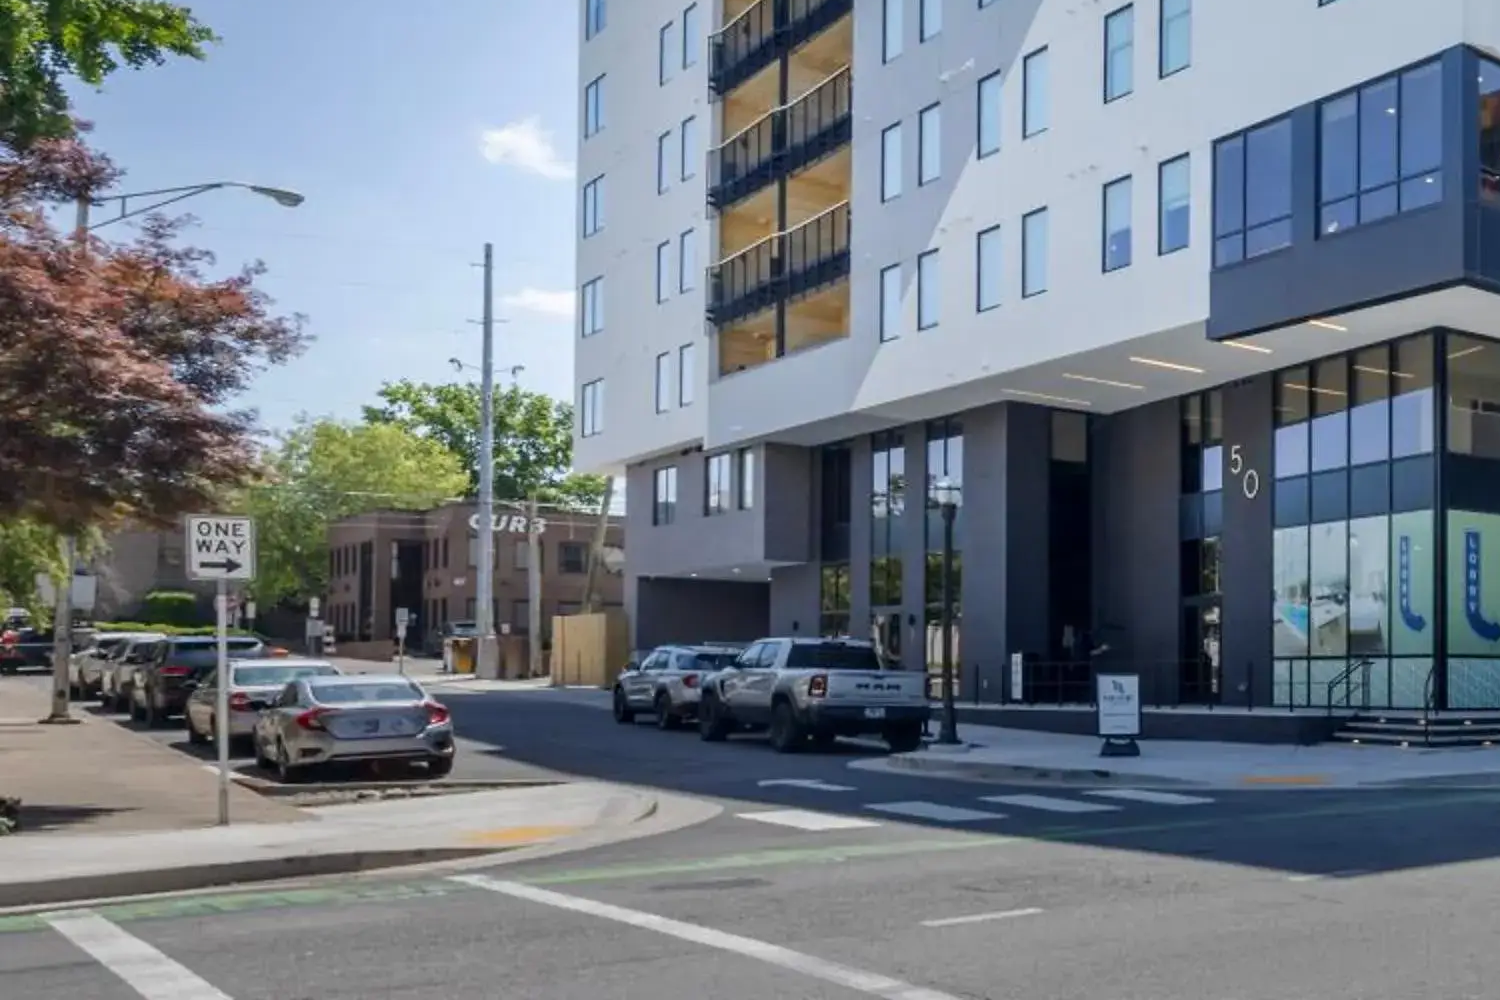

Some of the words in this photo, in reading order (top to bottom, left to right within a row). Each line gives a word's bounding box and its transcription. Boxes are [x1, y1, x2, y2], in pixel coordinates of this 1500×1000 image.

[1231, 445, 1259, 499] 50
[197, 521, 246, 537] ONE
[196, 540, 246, 554] WAY
